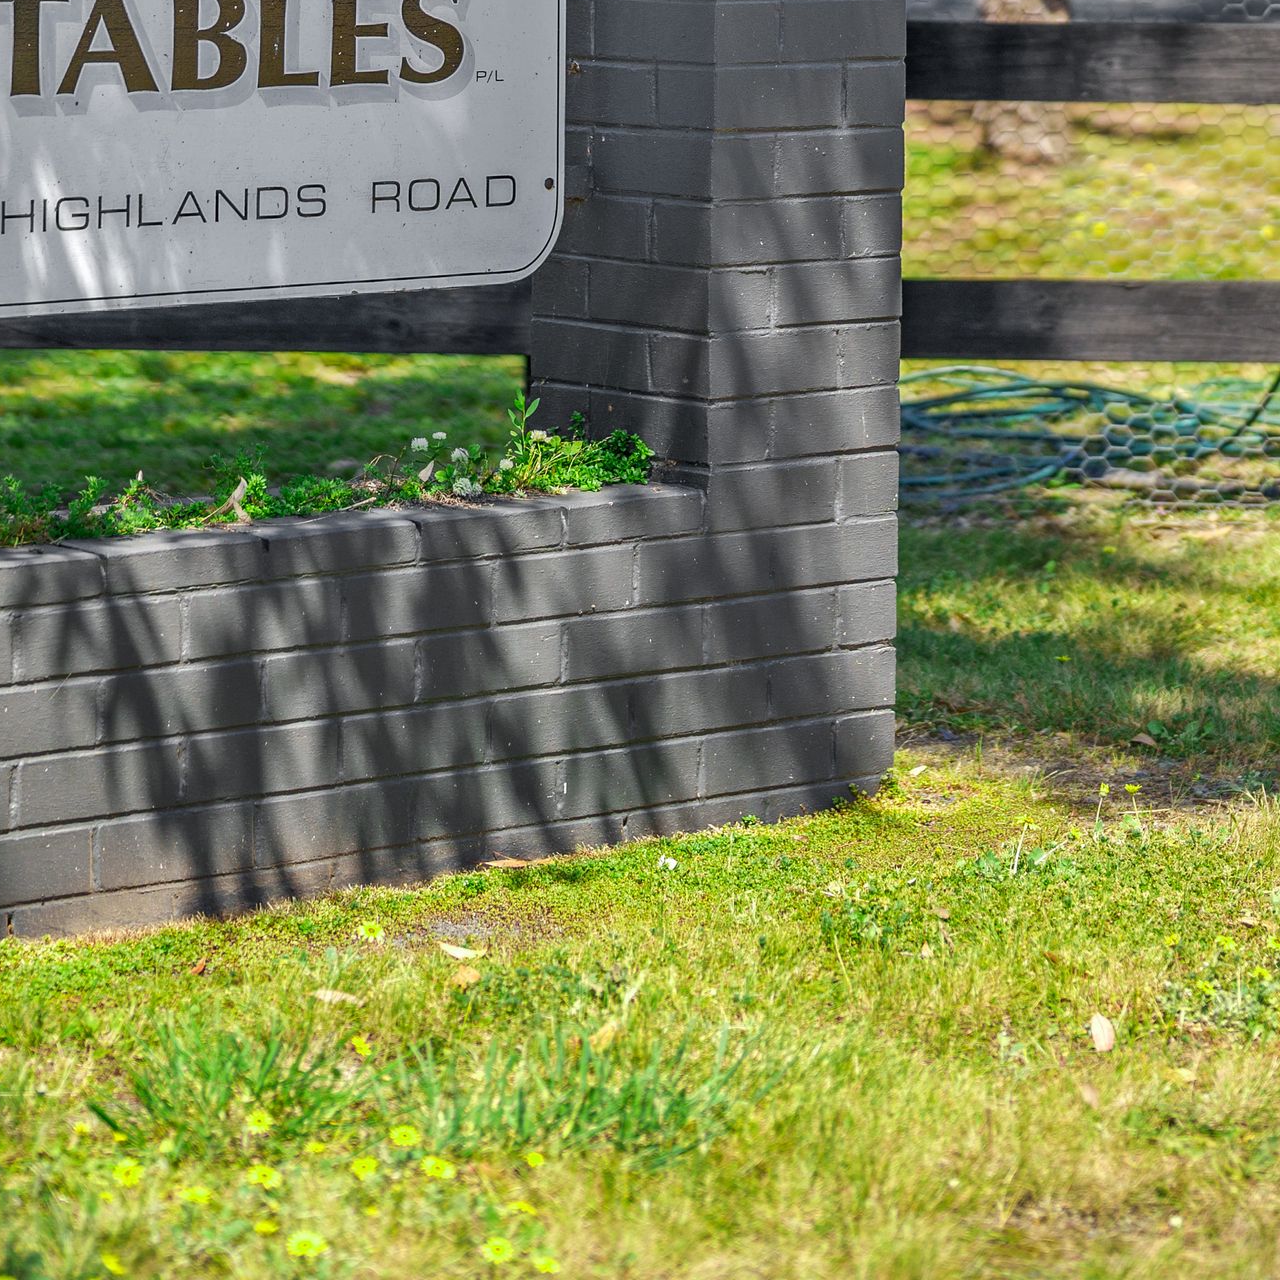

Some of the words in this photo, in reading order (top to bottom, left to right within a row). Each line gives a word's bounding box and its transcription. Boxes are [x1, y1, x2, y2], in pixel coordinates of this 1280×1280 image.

[476, 69, 505, 83] P/L
[0, 183, 327, 235] HIGHLANDS
[371, 174, 517, 214] ROAD
